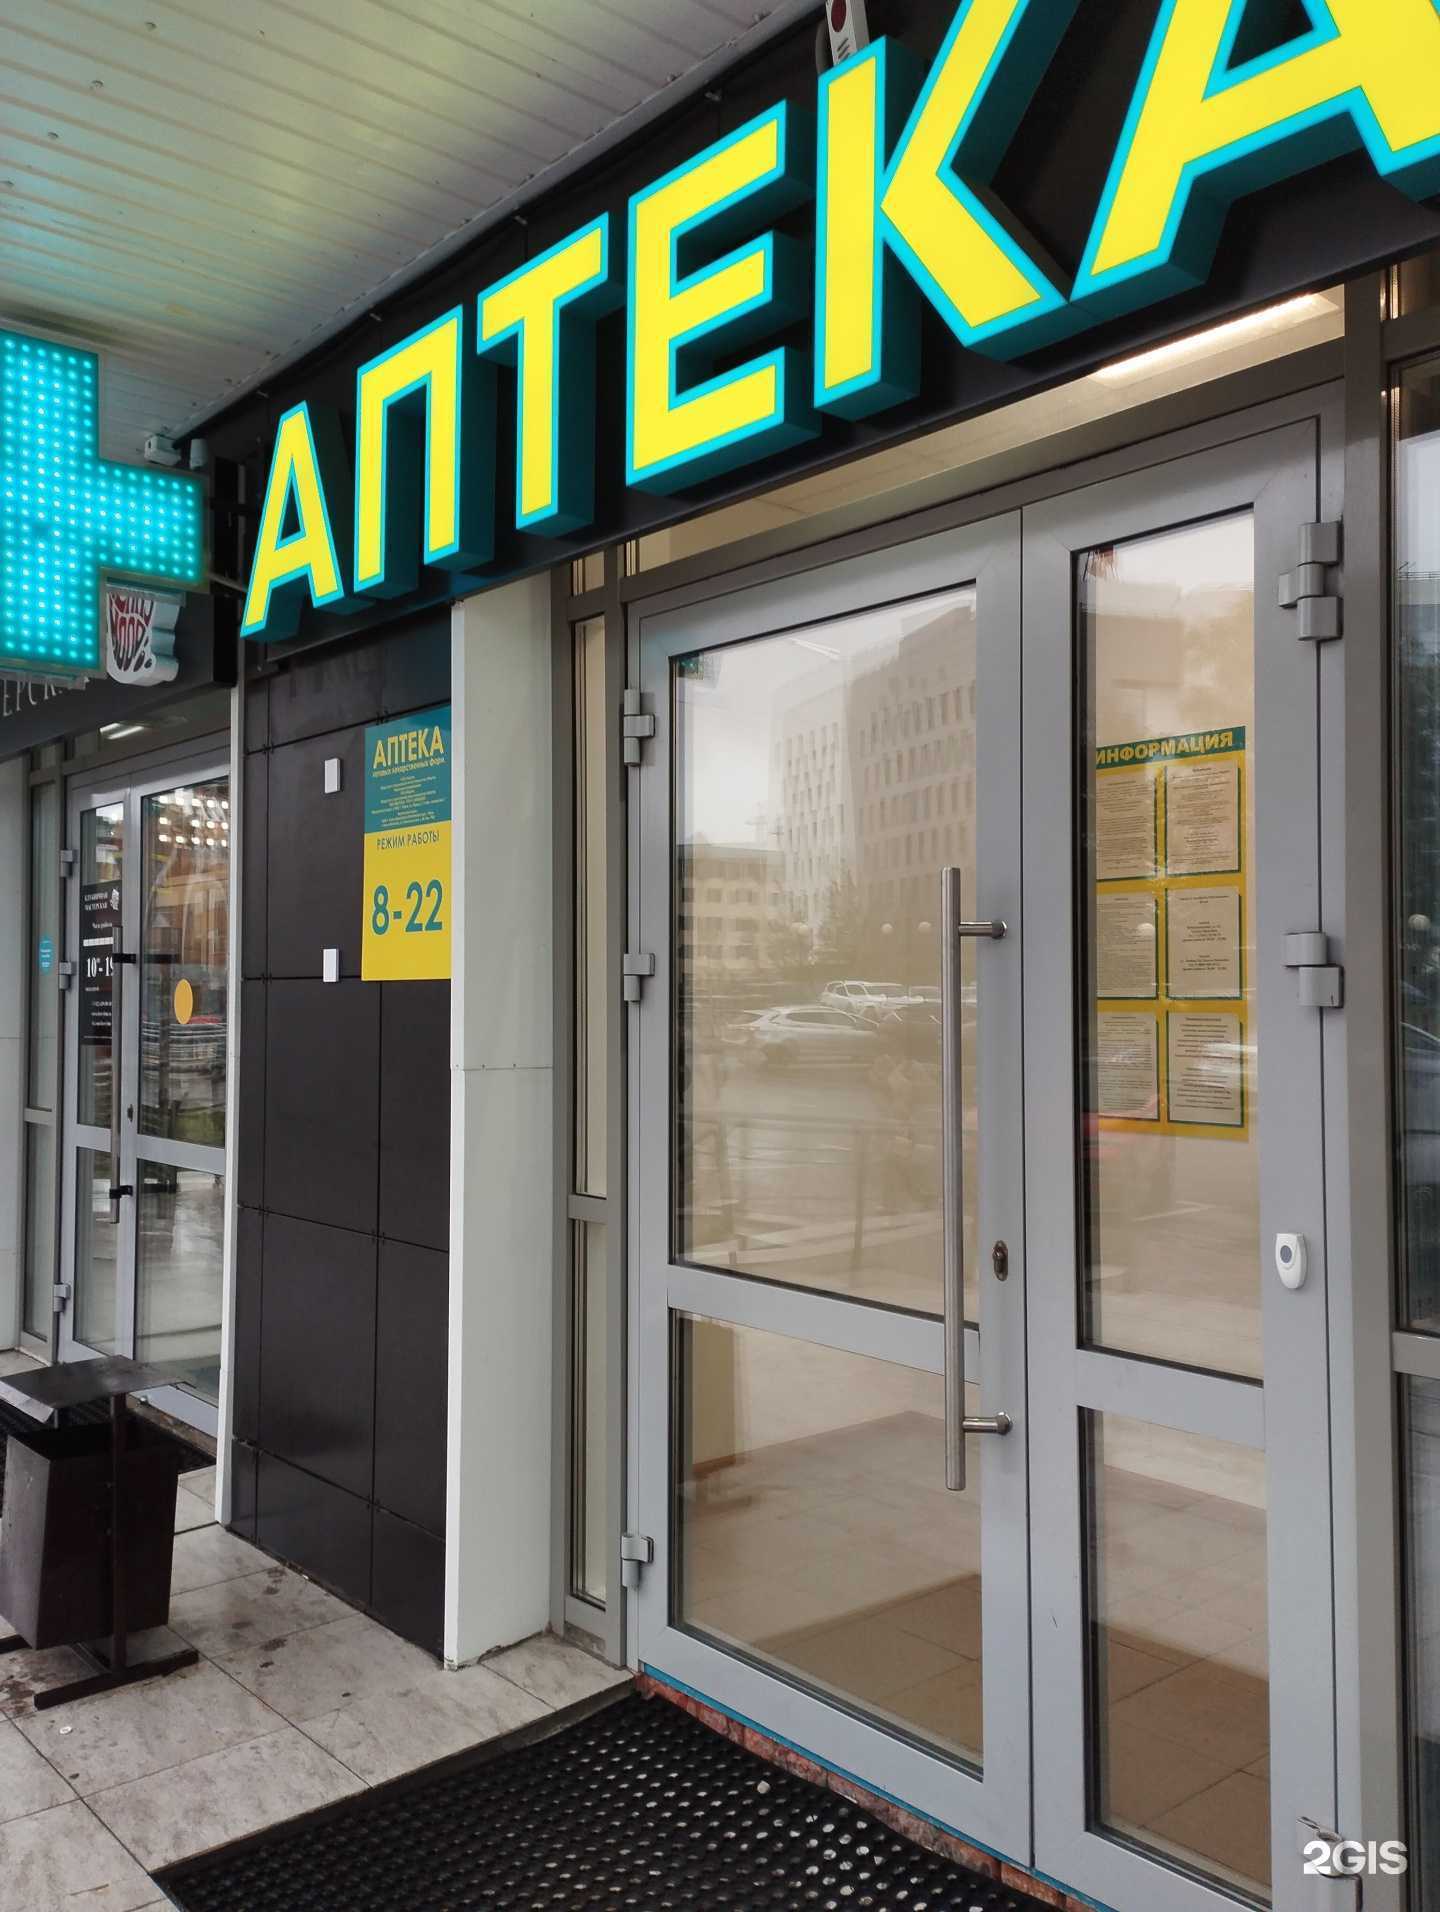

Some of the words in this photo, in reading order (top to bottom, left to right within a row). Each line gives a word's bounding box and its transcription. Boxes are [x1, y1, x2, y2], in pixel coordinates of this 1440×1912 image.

[239, 0, 1440, 640] АПТЕКА
[373, 725, 445, 769] АПТЕКА
[1096, 731, 1233, 765] ИНФОРМАЦИЯ
[377, 835, 406, 850] РЕЖИМ
[407, 830, 440, 847] РАБОТЫ
[372, 879, 443, 935] 8-22
